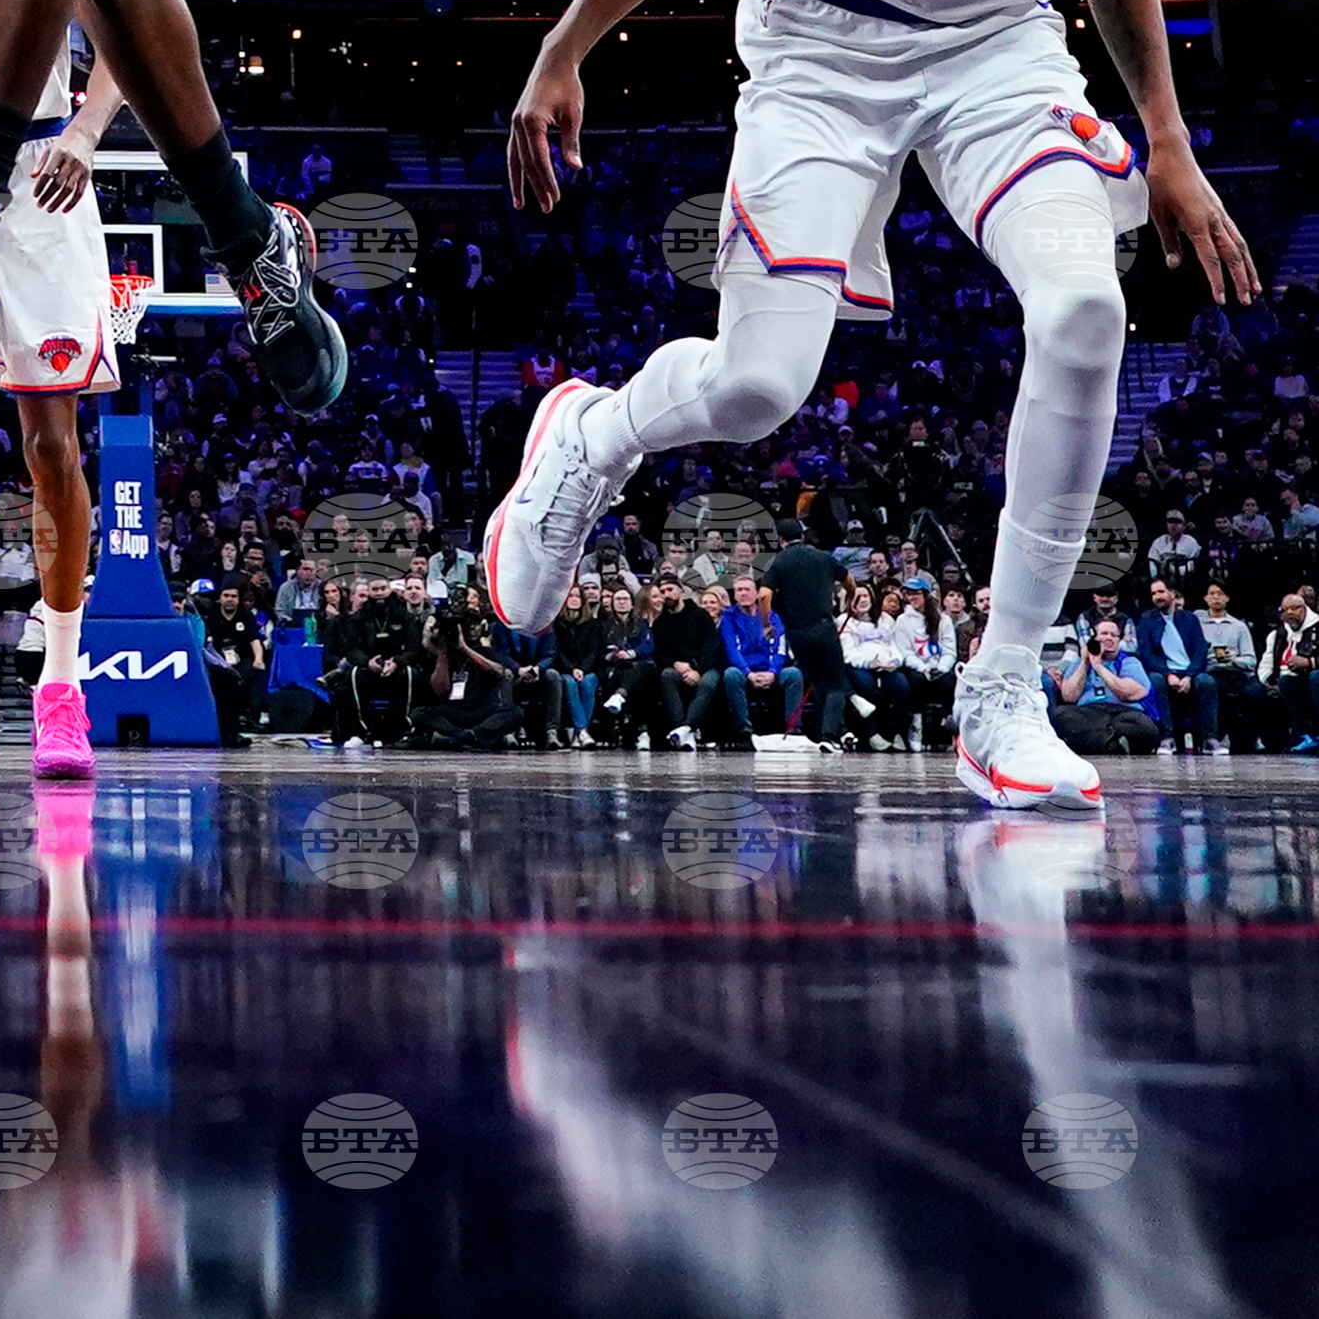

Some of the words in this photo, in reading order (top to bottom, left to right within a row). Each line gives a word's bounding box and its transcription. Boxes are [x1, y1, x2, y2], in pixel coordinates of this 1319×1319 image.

[115, 481, 142, 505] GET
[115, 505, 142, 530] THE
[121, 531, 149, 559] App
[79, 650, 188, 681] KIA
